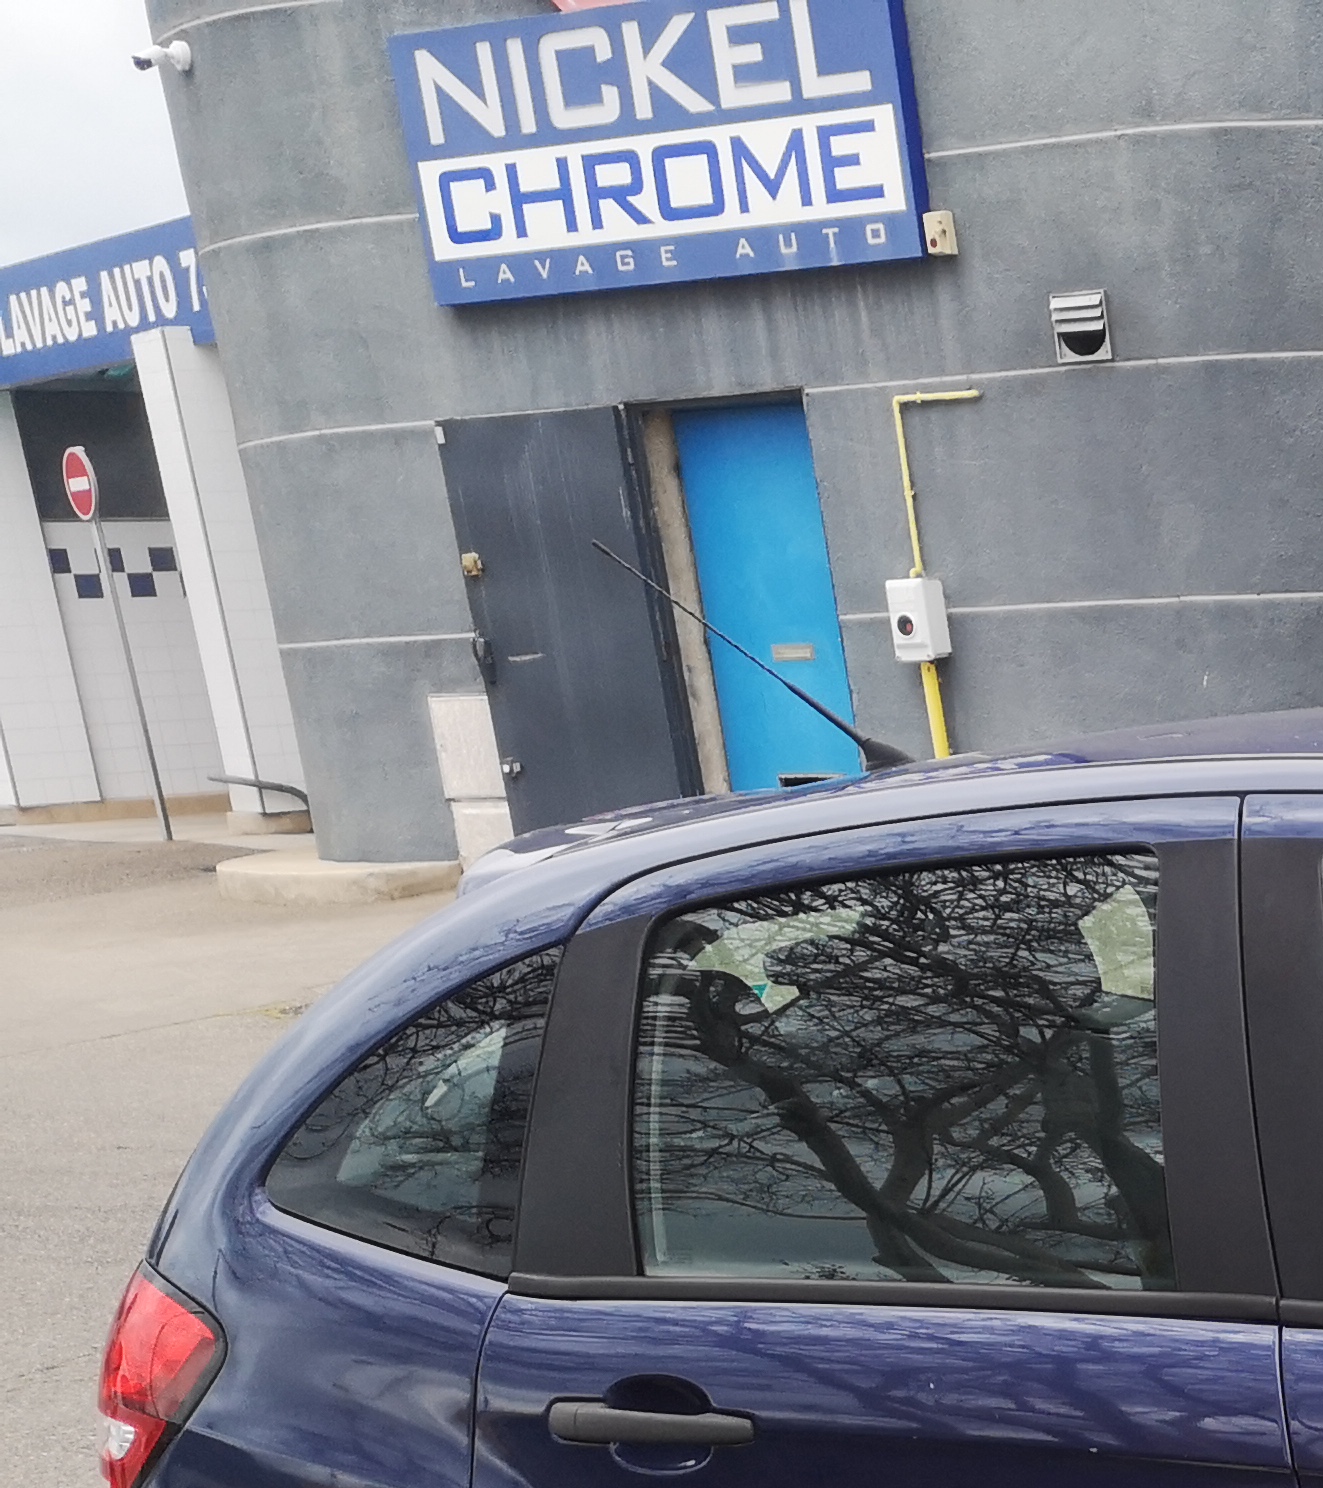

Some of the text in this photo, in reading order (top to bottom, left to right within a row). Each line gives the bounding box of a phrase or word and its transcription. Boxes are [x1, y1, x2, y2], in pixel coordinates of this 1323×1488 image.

[414, 0, 872, 146] NICKEL
[438, 118, 885, 246] CHROME
[0, 275, 98, 358] LAVAGE
[99, 255, 178, 334] AUTO
[459, 222, 887, 290] LAVAGE AUTO
